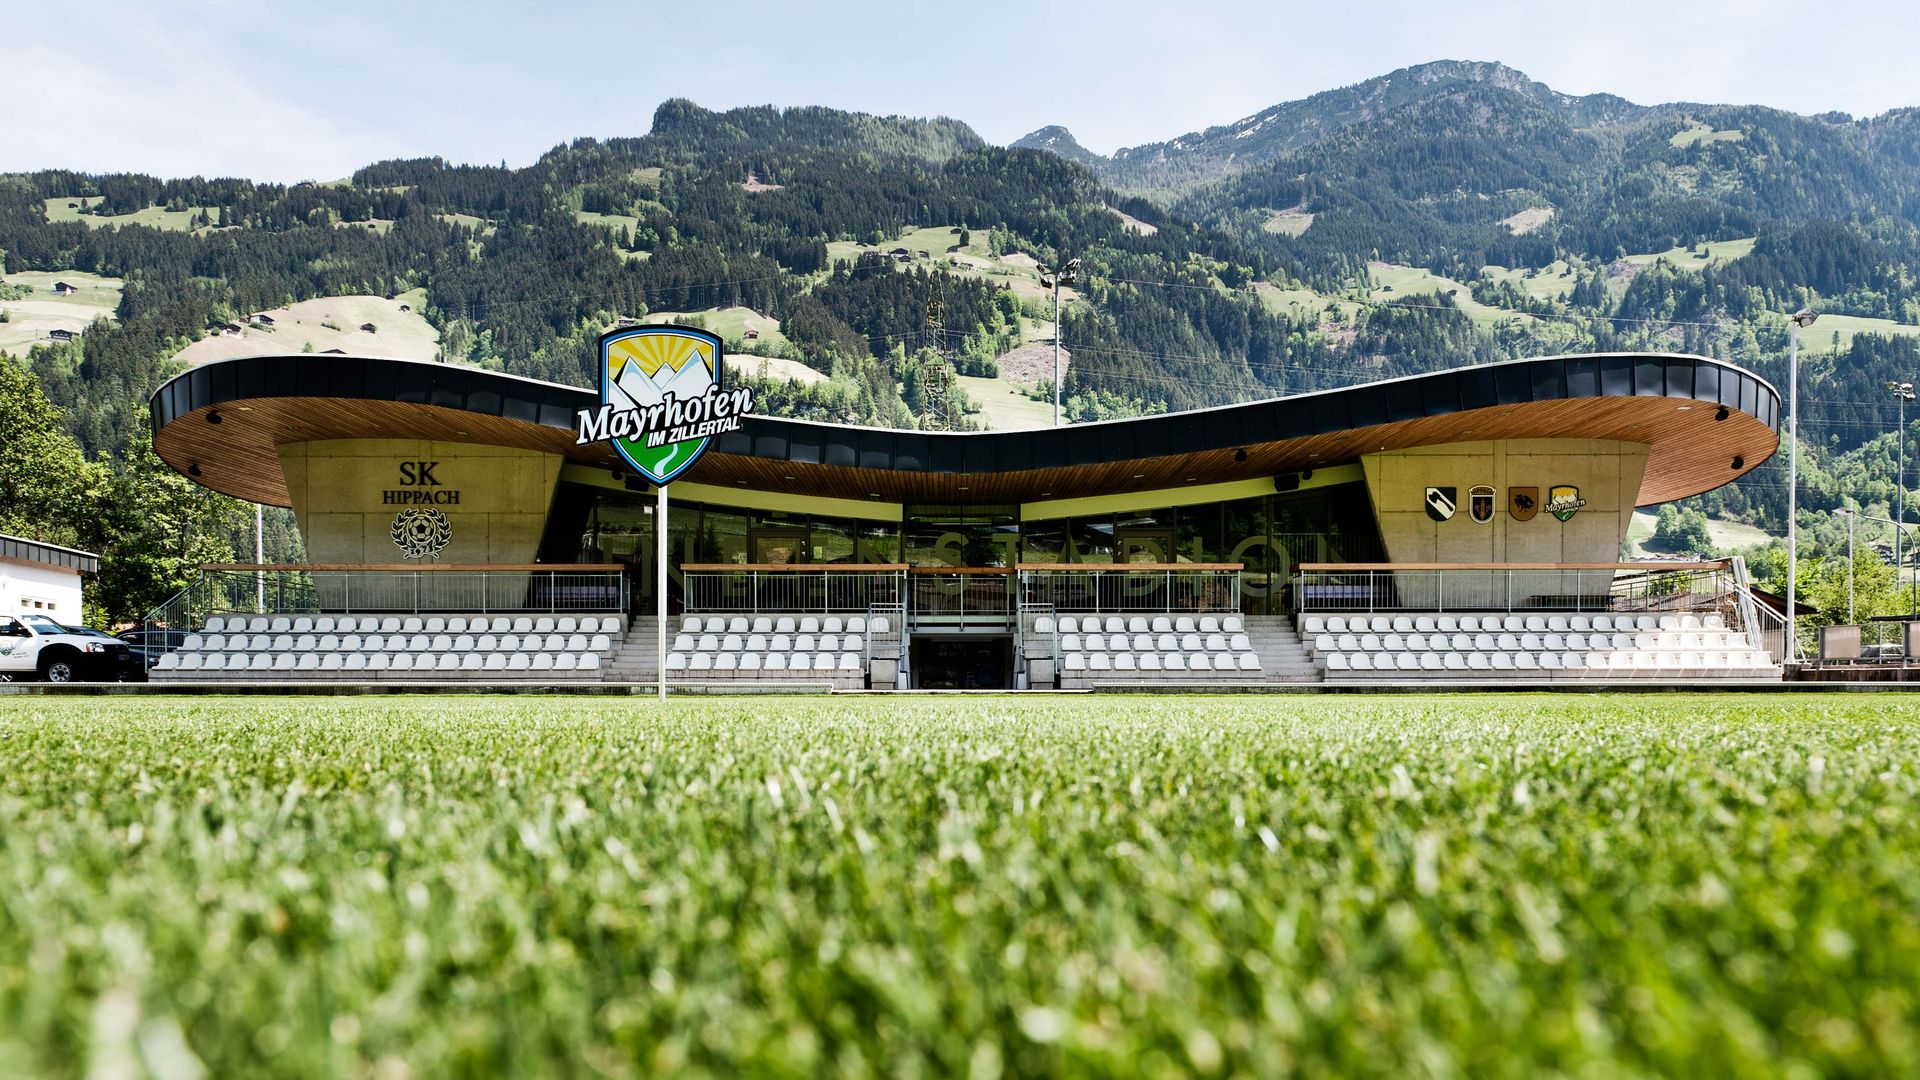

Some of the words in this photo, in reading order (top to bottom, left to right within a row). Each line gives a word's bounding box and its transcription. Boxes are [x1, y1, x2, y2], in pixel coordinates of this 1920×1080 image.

[576, 383, 754, 445] Mayrhofen
[647, 431, 666, 448] IM
[668, 415, 741, 444] ZILLERTAL
[399, 461, 442, 486] SK
[382, 490, 461, 505] HIPPACH
[1545, 498, 1586, 513] Mayrhofen
